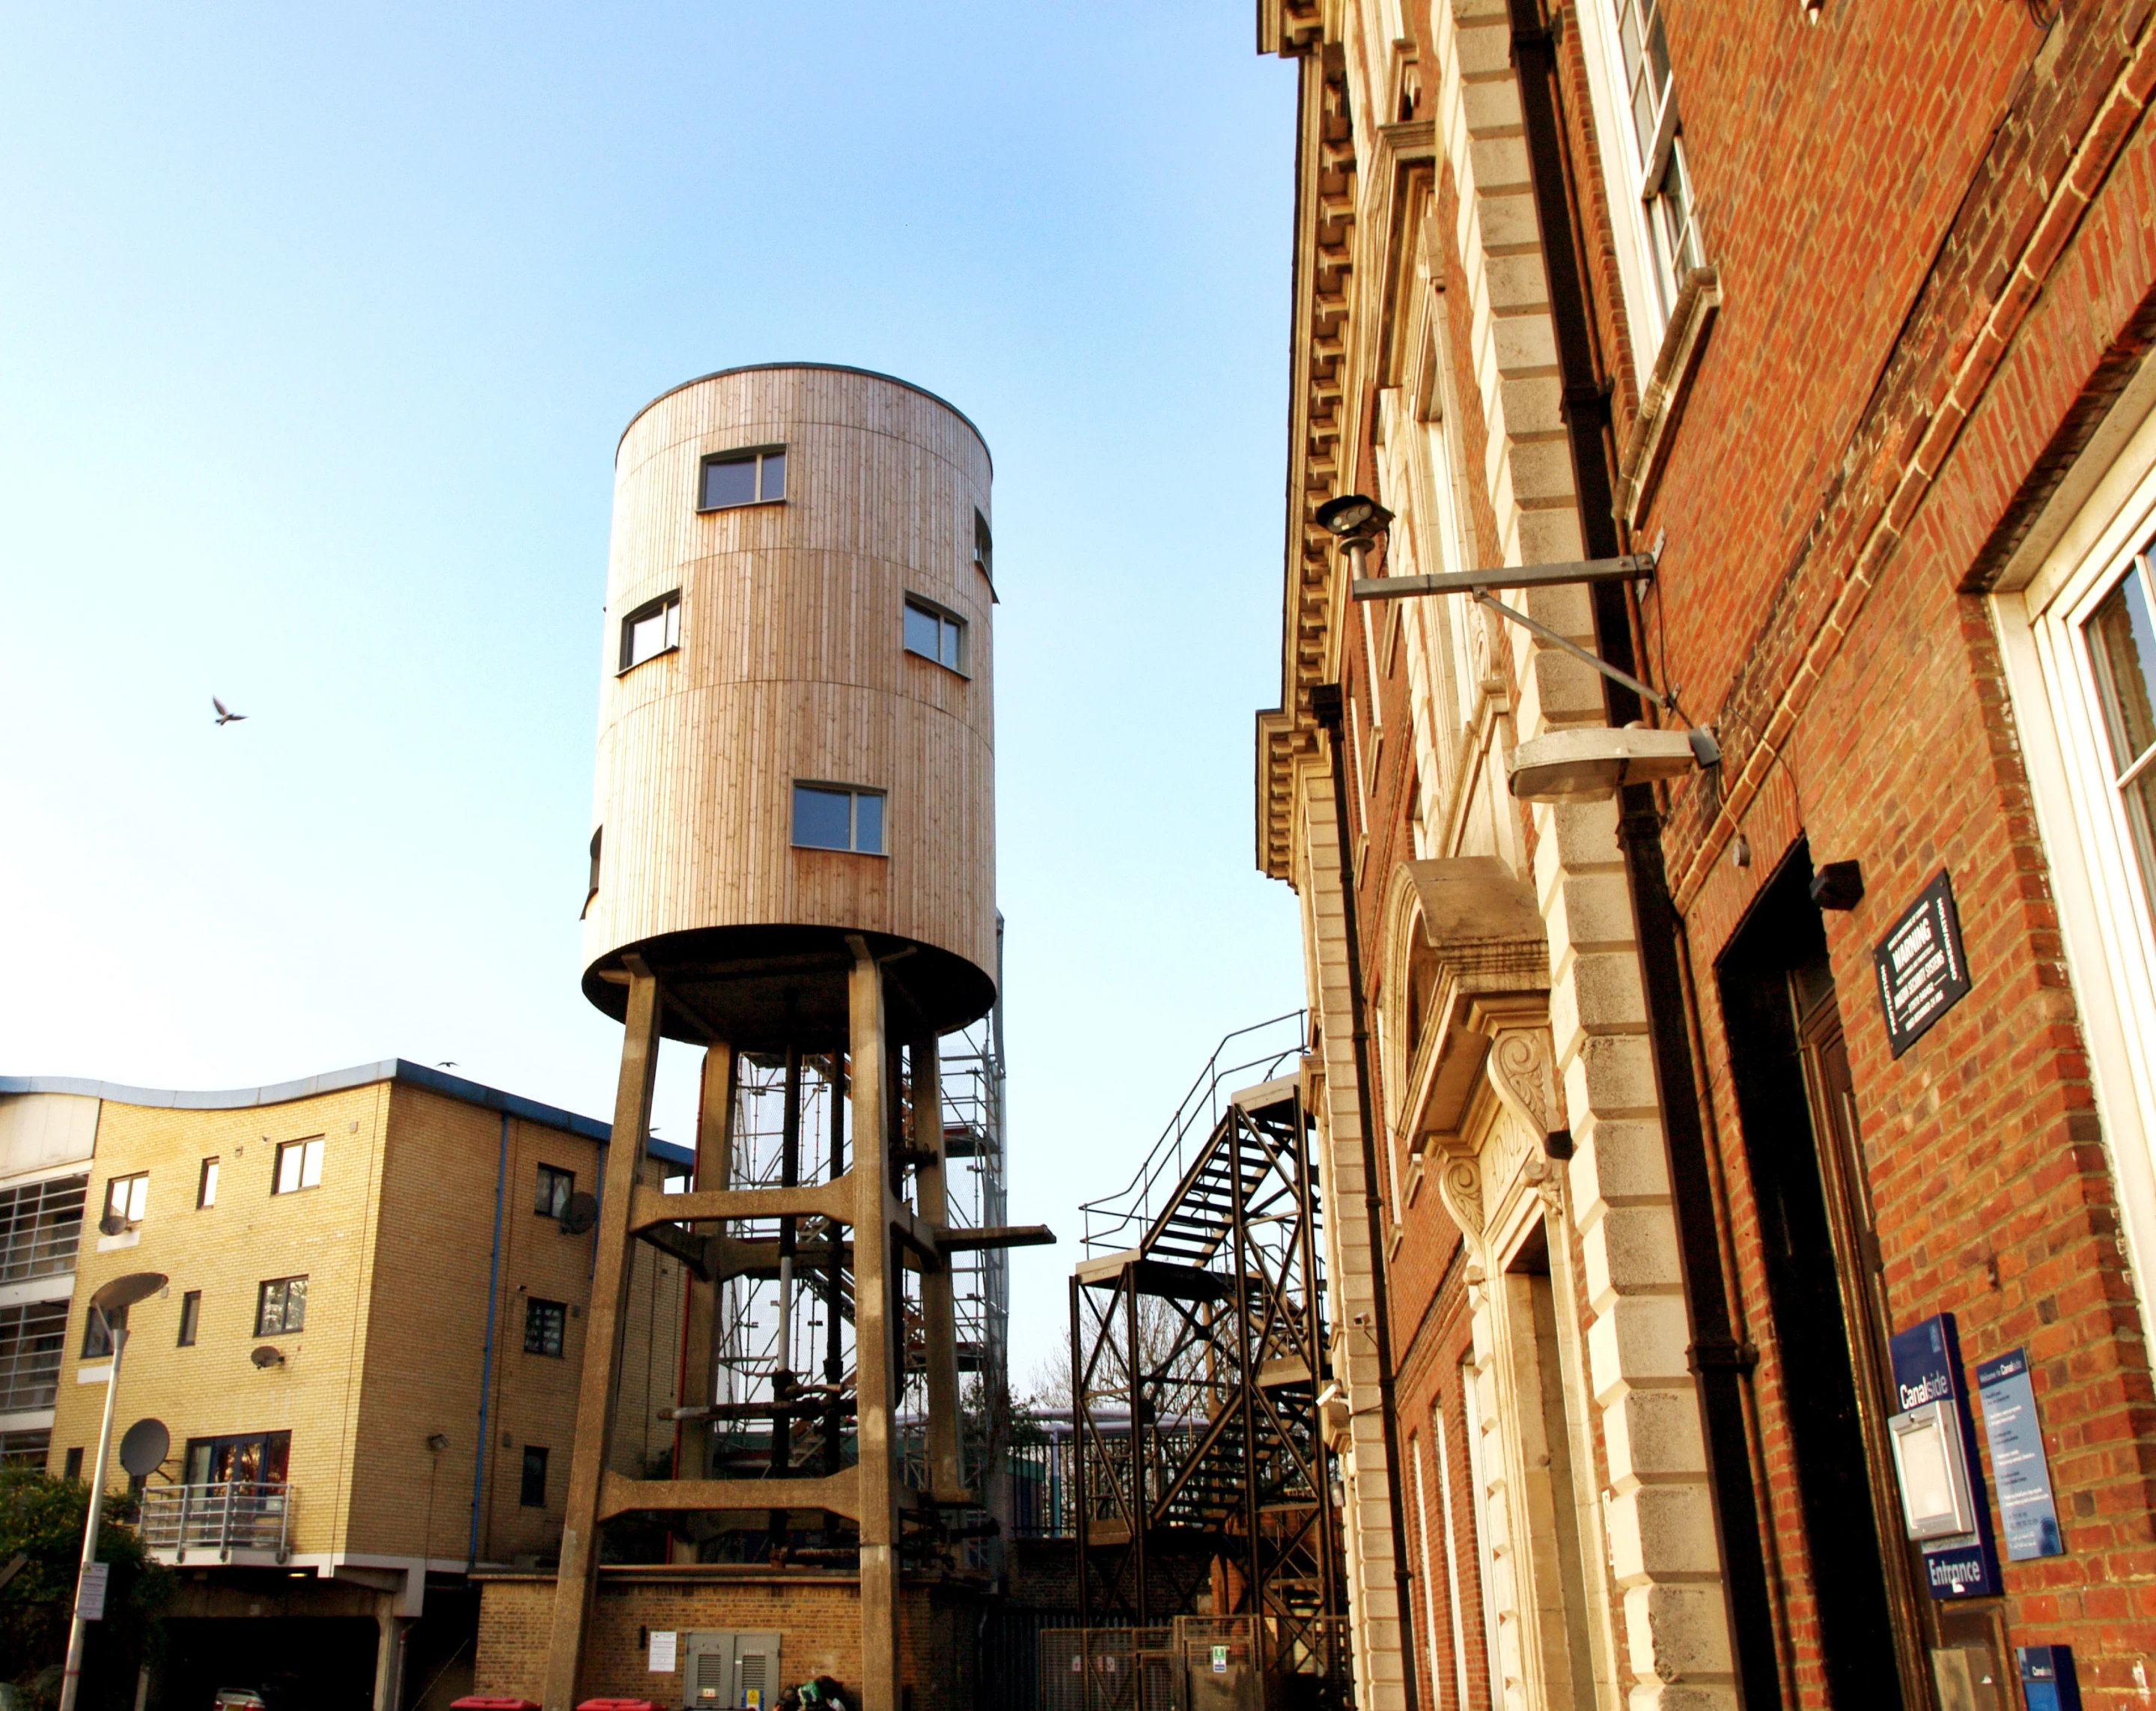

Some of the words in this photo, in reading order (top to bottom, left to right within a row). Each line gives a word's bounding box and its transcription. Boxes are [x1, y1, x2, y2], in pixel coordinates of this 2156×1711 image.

[1892, 917, 1931, 973] WARNING
[1900, 1370, 1948, 1409] Canalside
[1928, 1558, 1981, 1586] Entrance
